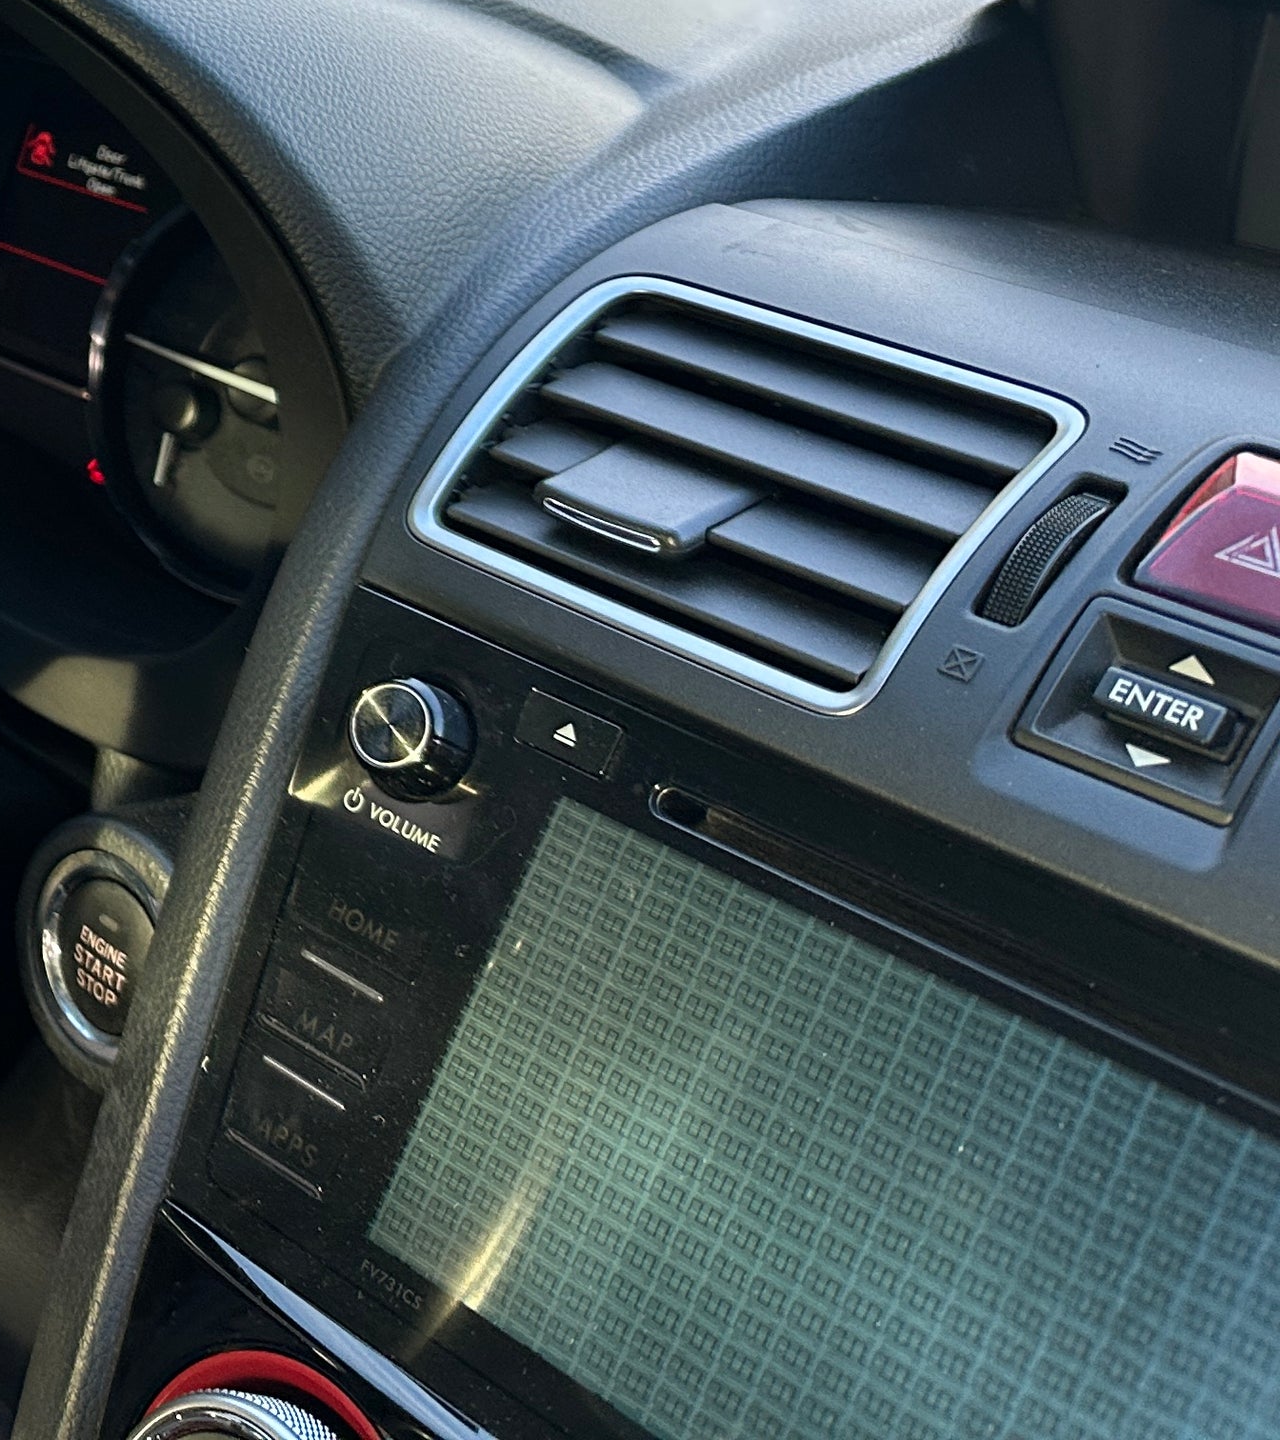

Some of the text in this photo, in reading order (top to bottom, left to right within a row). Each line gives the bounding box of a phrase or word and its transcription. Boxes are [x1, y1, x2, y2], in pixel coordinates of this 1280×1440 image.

[1108, 678, 1205, 731] ENTER
[369, 801, 443, 854] VOLUME
[80, 924, 128, 970] ENGINE
[329, 898, 400, 952] HOME
[73, 943, 127, 992] START
[76, 967, 119, 1008] STOP
[297, 1010, 355, 1055] MAP
[255, 1116, 318, 1169] APPS
[360, 1258, 424, 1311] FV731CS
